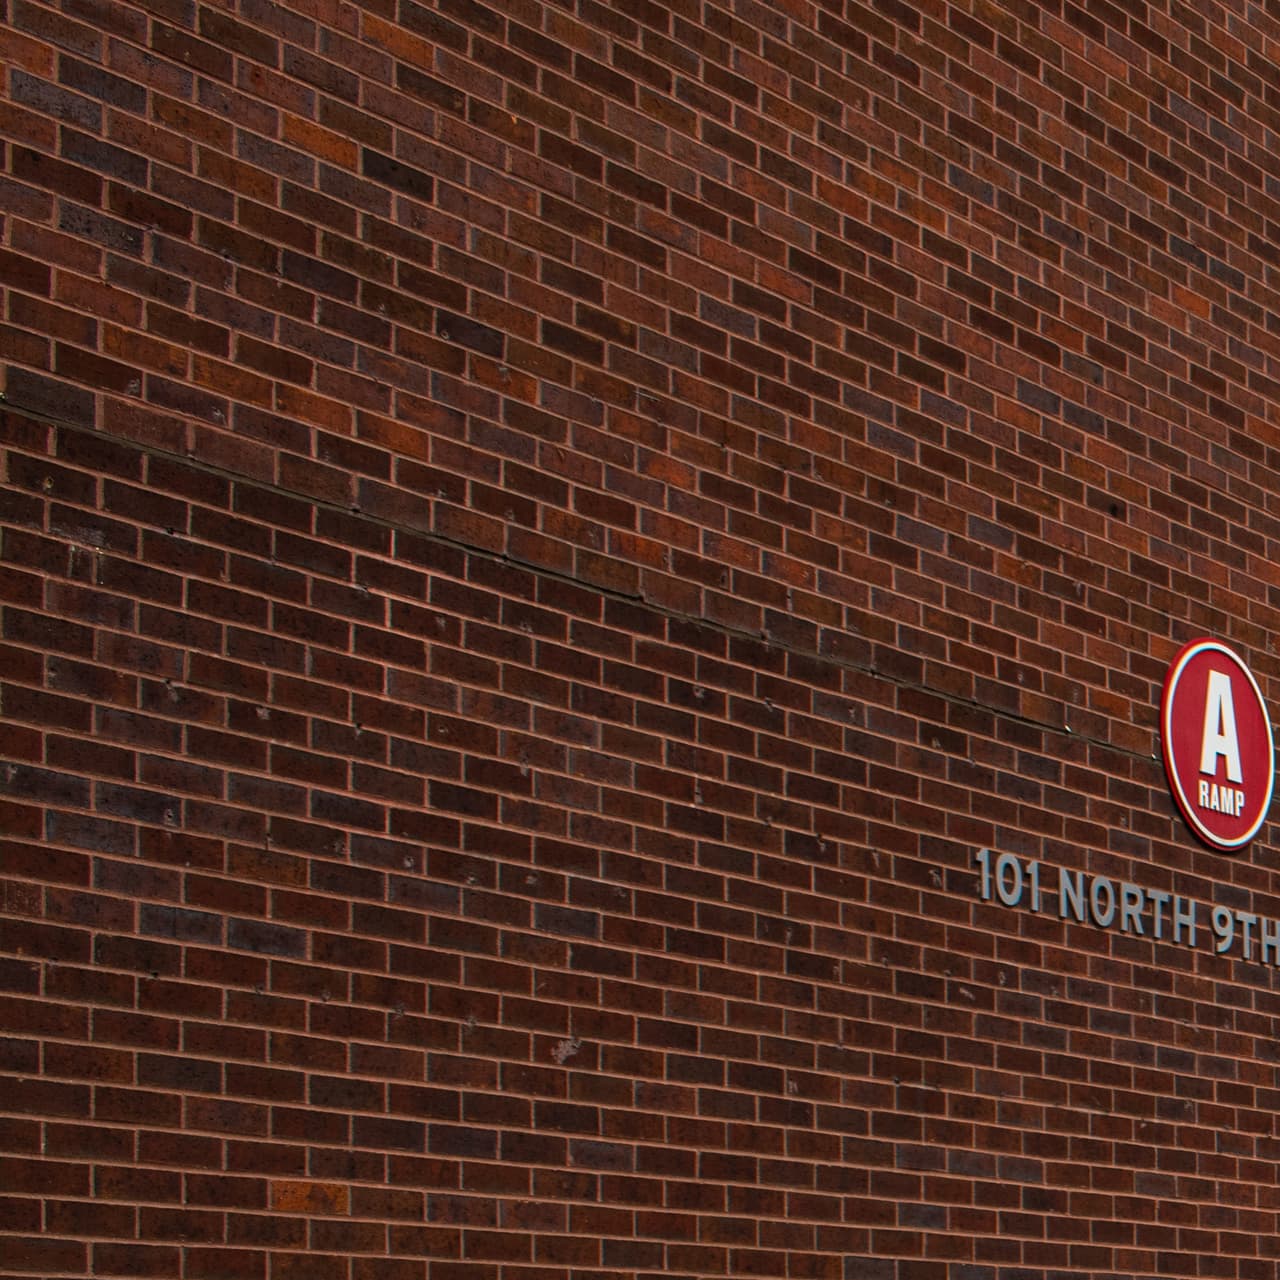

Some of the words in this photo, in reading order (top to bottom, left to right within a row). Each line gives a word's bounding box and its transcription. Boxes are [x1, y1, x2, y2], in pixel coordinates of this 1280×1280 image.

[1199, 668, 1243, 784] A
[1198, 781, 1246, 818] RAMP
[976, 849, 1041, 912] 101
[1057, 869, 1198, 948] NORTH
